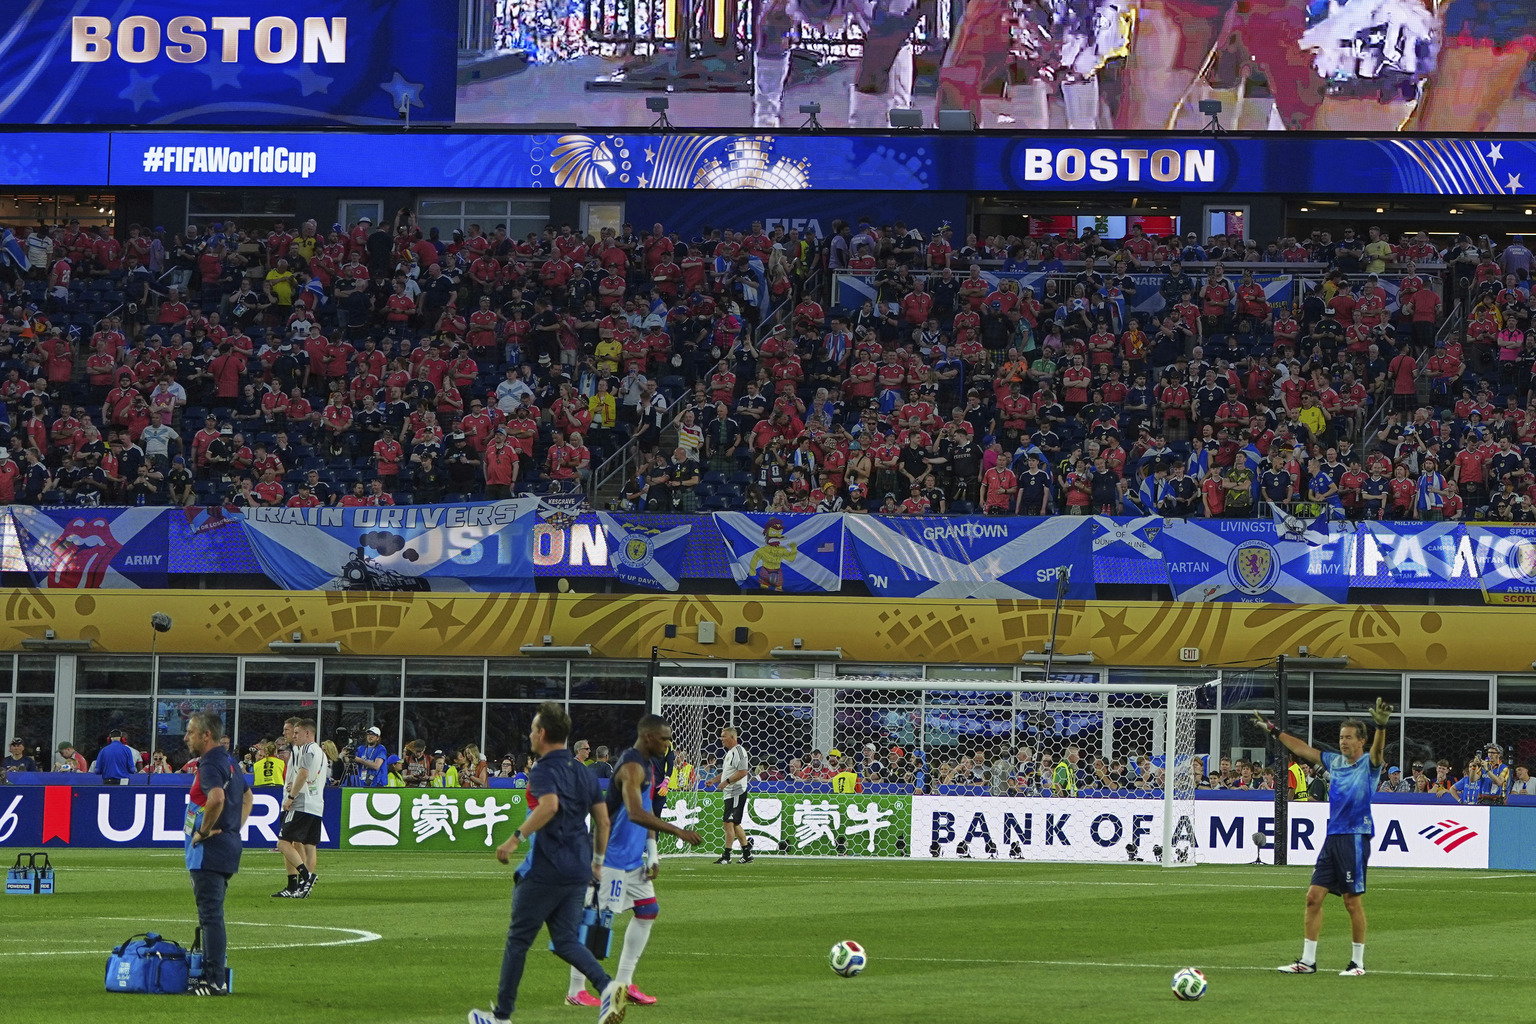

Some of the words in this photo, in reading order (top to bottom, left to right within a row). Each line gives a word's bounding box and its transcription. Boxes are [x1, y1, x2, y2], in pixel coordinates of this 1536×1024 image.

[71, 15, 347, 64] BOSTON
[143, 146, 317, 178] #FIFAWorldCup
[1024, 148, 1215, 183] BOSTON
[243, 506, 343, 528] TRAIN
[353, 503, 518, 529] DRIVERS
[923, 524, 1008, 541] GRANTOWN
[124, 555, 162, 566] ARMY
[1167, 561, 1209, 573] TARTAN
[1307, 563, 1341, 575] ARMY
[1184, 649, 1196, 659] EXIT
[98, 791, 330, 842] ULR
[411, 794, 511, 847] 蒙牛
[793, 799, 893, 852] 蒙牛
[932, 812, 1070, 846] BANK
[1091, 814, 1154, 848] OF
[1172, 815, 1408, 853] AMERA
[610, 879, 622, 897] 16
